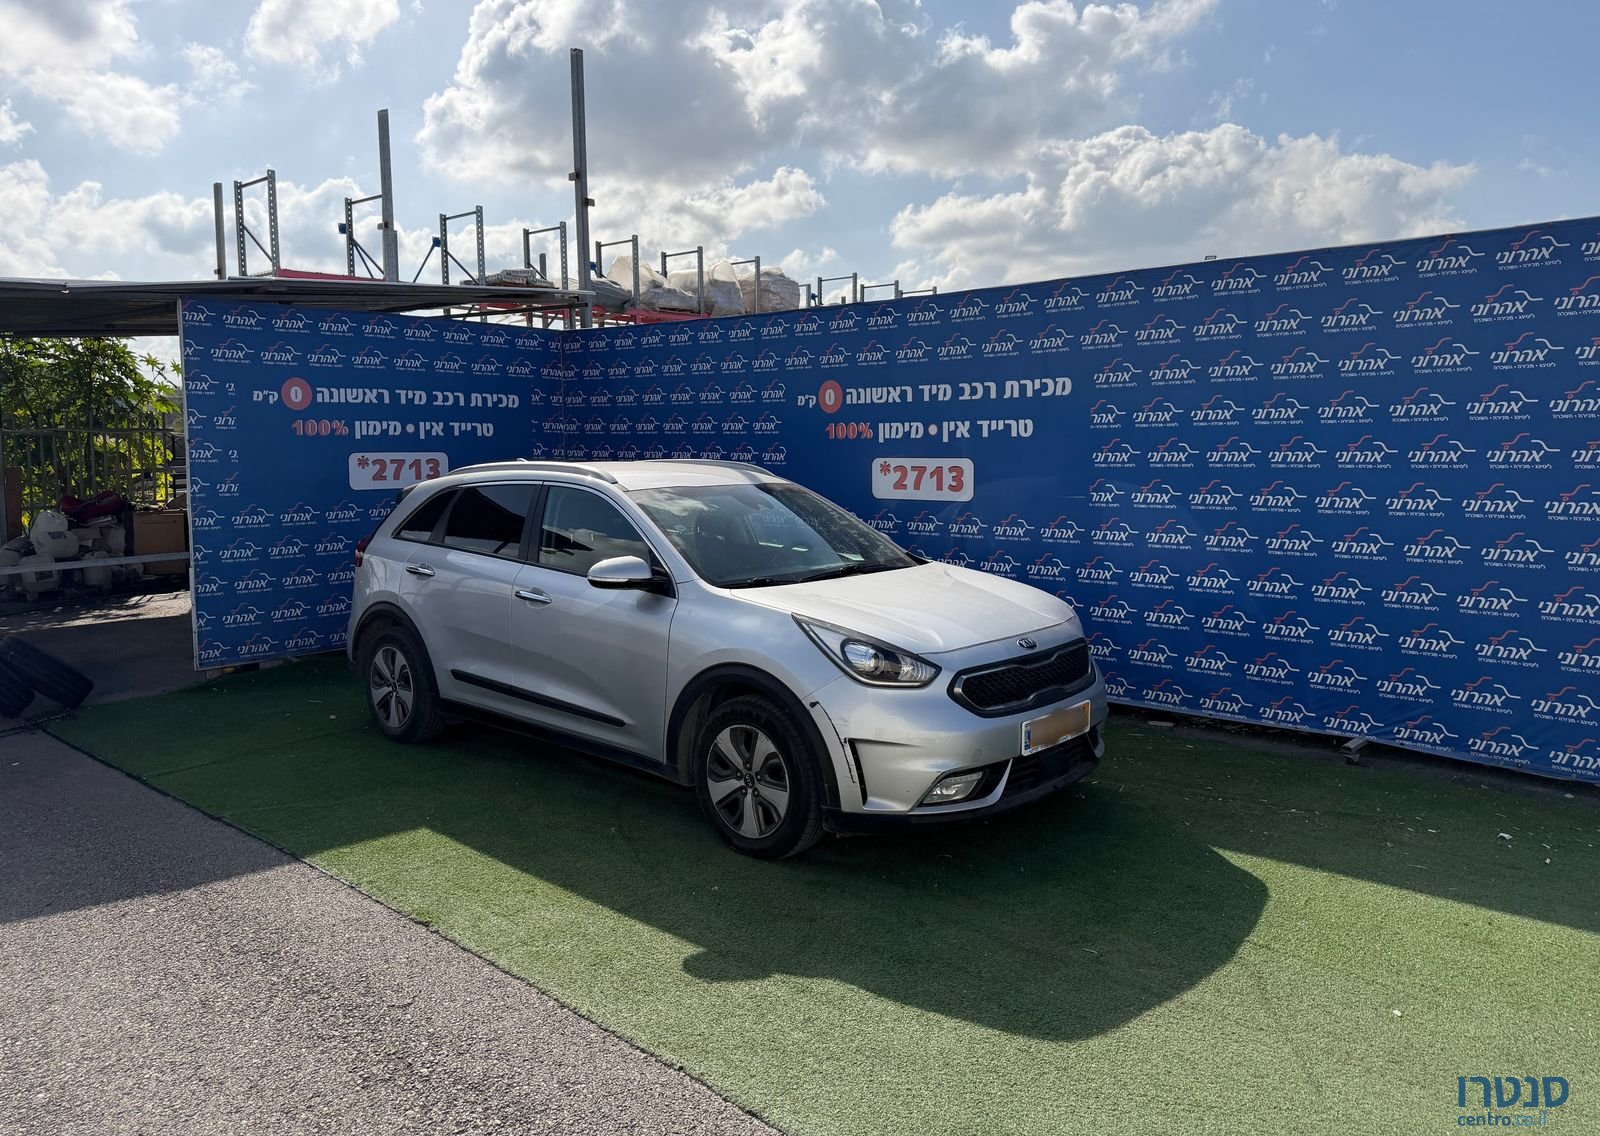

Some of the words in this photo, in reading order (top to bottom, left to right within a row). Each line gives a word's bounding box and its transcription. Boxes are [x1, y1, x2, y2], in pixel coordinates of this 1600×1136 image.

[1494, 246, 1555, 264] אהרוני
[1415, 255, 1470, 272] אהרוני
[1273, 270, 1321, 285] אהרוני
[1341, 263, 1392, 279] אהרוני
[1152, 283, 1192, 297] אהרוני
[1211, 276, 1255, 291] אהרוני
[1044, 295, 1079, 308] אהרוני
[1096, 289, 1134, 302] אהרוני
[1392, 306, 1446, 322] אהרוני
[1470, 300, 1528, 316] אהרוני
[1254, 318, 1300, 332] אהרוני
[1320, 312, 1370, 327] אהרוני
[1135, 327, 1175, 340] אהרוני
[1193, 322, 1235, 336] אהרוני
[1029, 337, 1064, 349] אהרוני
[1080, 332, 1117, 345] אהרוני
[1411, 353, 1465, 367] אהרוני
[1489, 348, 1549, 363] אהרוני
[1208, 364, 1251, 377] אהרוני
[1270, 361, 1317, 374] אהרוני
[1337, 357, 1388, 371] אהרוני
[1094, 371, 1131, 383] אהרוני
[1149, 368, 1190, 380] אהרוני
[316, 387, 390, 404] ראשונה
[846, 385, 912, 405] ראשונה
[918, 383, 952, 402] מיד
[958, 380, 996, 400] רכב
[1003, 377, 1072, 400] מכירת
[395, 389, 426, 404] מיד
[432, 391, 464, 406] רכב
[470, 393, 520, 408] מכירת
[1191, 409, 1233, 420] אהרוני
[1251, 407, 1297, 419] אהרוני
[1317, 405, 1366, 418] אהרוני
[1388, 403, 1442, 416] אהרוני
[1465, 401, 1523, 414] אהרוני
[1133, 411, 1172, 422] אהרוני
[292, 420, 348, 436] 100%
[354, 420, 402, 440] מימון
[419, 421, 444, 440] אין
[450, 421, 494, 436] טרייד
[826, 422, 874, 440] 100%
[878, 422, 924, 443] מימון
[942, 420, 970, 442] אין
[976, 418, 1034, 438] טרייד
[1092, 452, 1130, 462] אהרוני
[1148, 451, 1188, 462] אהרוני
[1206, 451, 1249, 462] אהרוני
[1268, 451, 1314, 462] אהרוני
[1335, 451, 1385, 462] אהרוני
[1407, 450, 1462, 462] אהרוני
[1486, 450, 1545, 462] אהרוני
[1131, 492, 1171, 503] אהרוני
[1189, 493, 1231, 505] אהרוני
[1249, 495, 1294, 506] אהרוני
[1315, 496, 1363, 508] אהרוני
[1385, 498, 1438, 510] אהרוני
[1461, 499, 1518, 512] אהרוני
[993, 525, 1025, 536] אהרוני
[1040, 527, 1075, 538] אהרוני
[1091, 529, 1128, 541] אהרוני
[1146, 532, 1185, 544] אהרוני
[1204, 535, 1247, 547] אהרוני
[1265, 538, 1311, 550] אהרוני
[1331, 541, 1381, 554] אהרוני
[1403, 544, 1457, 558] אהרוני
[1480, 548, 1539, 562] אהרוני
[1026, 564, 1061, 576] אהרוני
[1076, 568, 1113, 580] אהרוני
[1129, 571, 1168, 584] אהרוני
[1186, 575, 1228, 588] אהרוני
[1246, 580, 1291, 593] אהרוני
[1311, 585, 1359, 599] אהרוני
[1380, 589, 1433, 604] אהרוני
[1456, 595, 1512, 610] אהרוני
[1090, 606, 1127, 619] אהרוני
[1144, 611, 1183, 624] אהרוני
[1202, 617, 1244, 630] אהרוני
[1262, 623, 1307, 637] אהרוני
[1327, 629, 1376, 644] אהרוני
[1398, 636, 1451, 652] אהרוני
[1128, 649, 1167, 663] אהרוני
[1474, 643, 1532, 660] אהרוני
[1184, 656, 1226, 670] אהרוני
[1243, 663, 1288, 678] אהרוני
[1307, 671, 1355, 687] אהרוני
[1375, 680, 1427, 696] אהרוני
[1450, 689, 1506, 706] אהרוני
[1199, 697, 1241, 713] אהרוני
[1530, 699, 1591, 718] אהרוני
[1259, 707, 1304, 723] אהרוני
[1323, 716, 1371, 733] אהרוני
[1392, 726, 1445, 744] אהרוני
[1467, 738, 1524, 756] אהרוני
